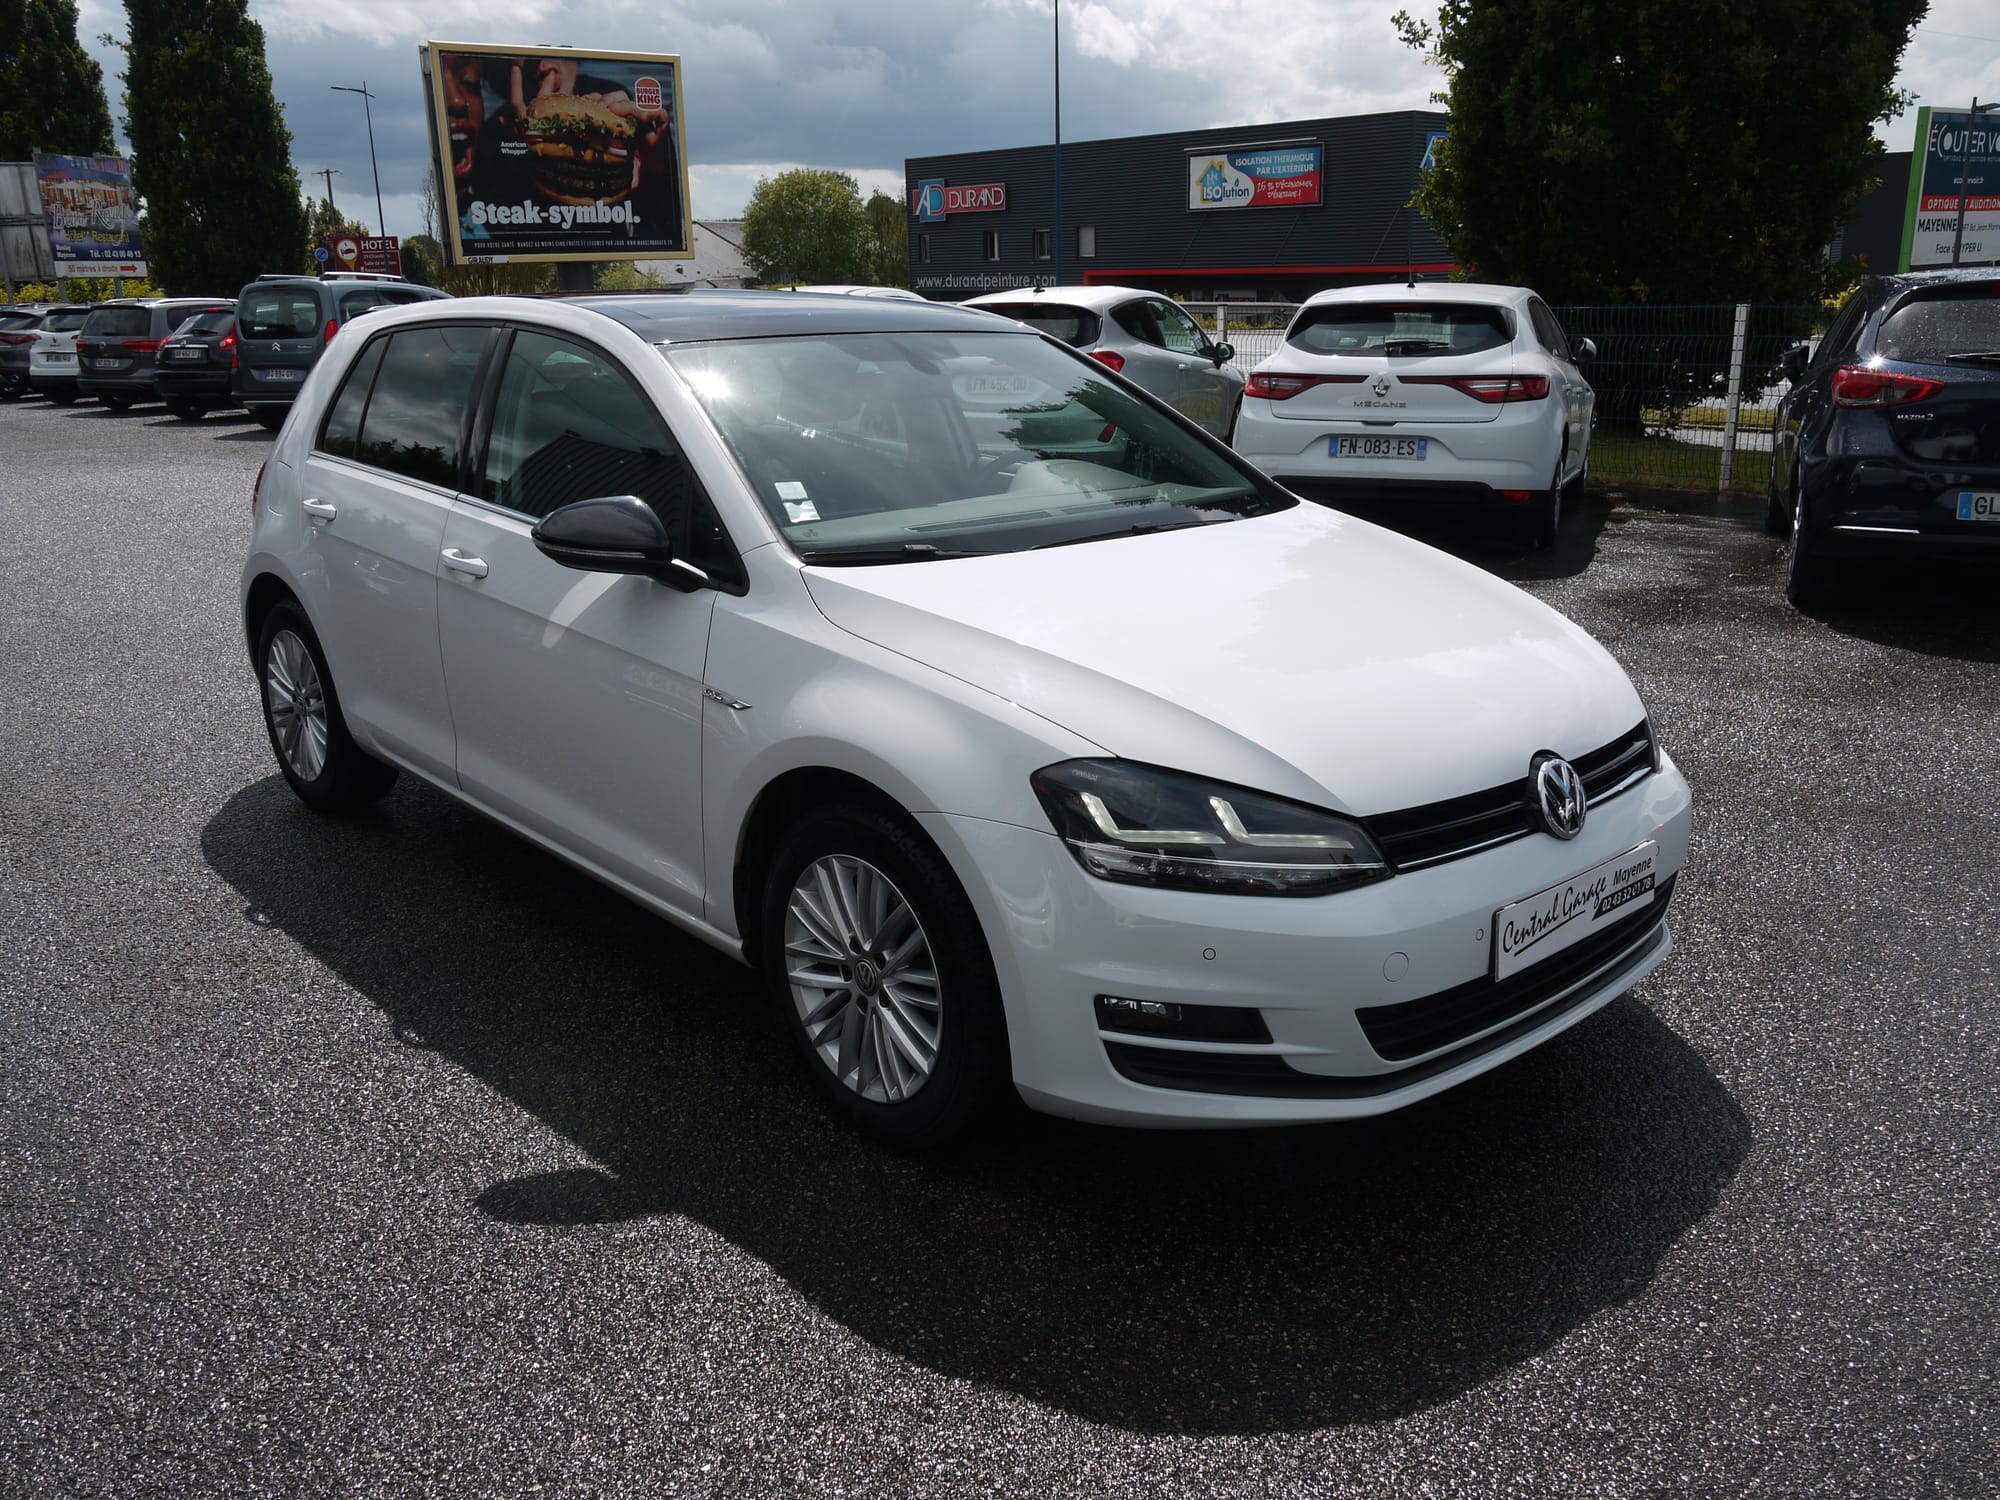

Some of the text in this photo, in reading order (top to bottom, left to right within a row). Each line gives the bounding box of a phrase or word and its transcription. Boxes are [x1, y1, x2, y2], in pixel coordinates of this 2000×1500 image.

[637, 87, 659, 95] BURGER
[637, 94, 660, 104] KING
[1235, 153, 1314, 167] ISOLATION THERMIQUE
[1256, 167, 1269, 175] PAR
[949, 187, 1004, 209] DURAND
[1928, 199, 1957, 209] OPTIQUE
[471, 200, 640, 230] Steak-symbol.
[1917, 217, 1957, 232] MAYENNE
[361, 239, 396, 250] HOTEL
[1936, 244, 1950, 253] Face
[1353, 401, 1407, 409] MEGANE
[1340, 438, 1416, 456] FN-083-ES
[1503, 857, 1652, 953] Central Garage Mayenne
